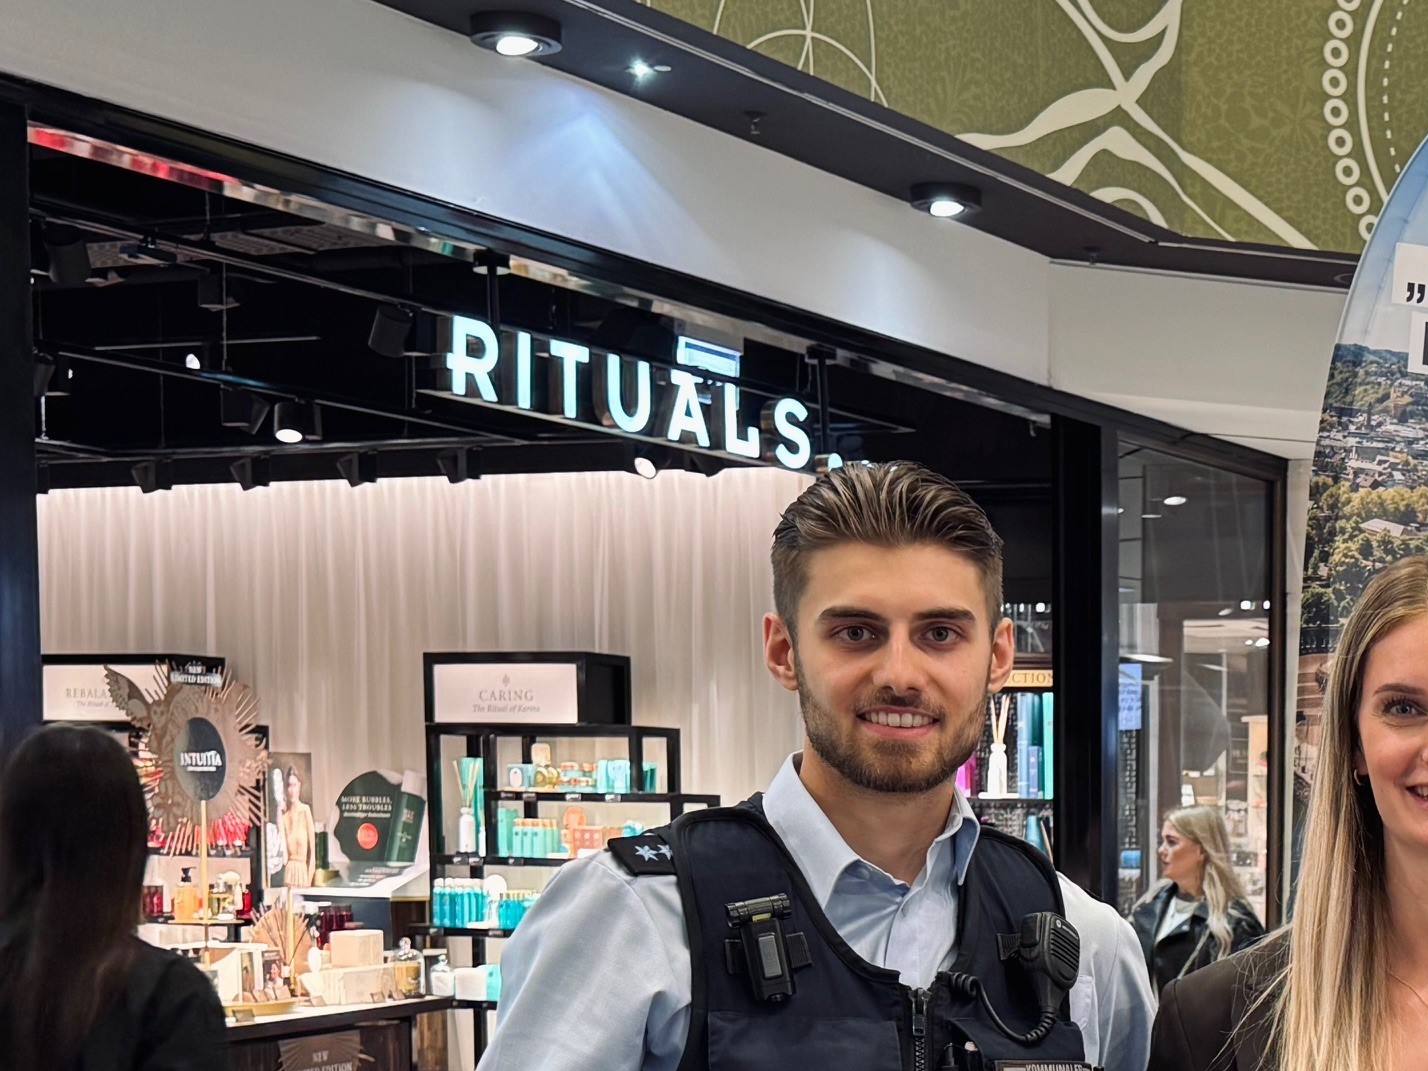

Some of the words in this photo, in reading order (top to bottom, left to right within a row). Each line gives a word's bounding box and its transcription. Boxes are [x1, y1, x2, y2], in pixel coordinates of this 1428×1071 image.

[66, 687, 112, 699] REBALA
[479, 689, 534, 702] CARING
[472, 704, 485, 713] The
[487, 704, 509, 713] Ritual
[509, 704, 518, 713] of
